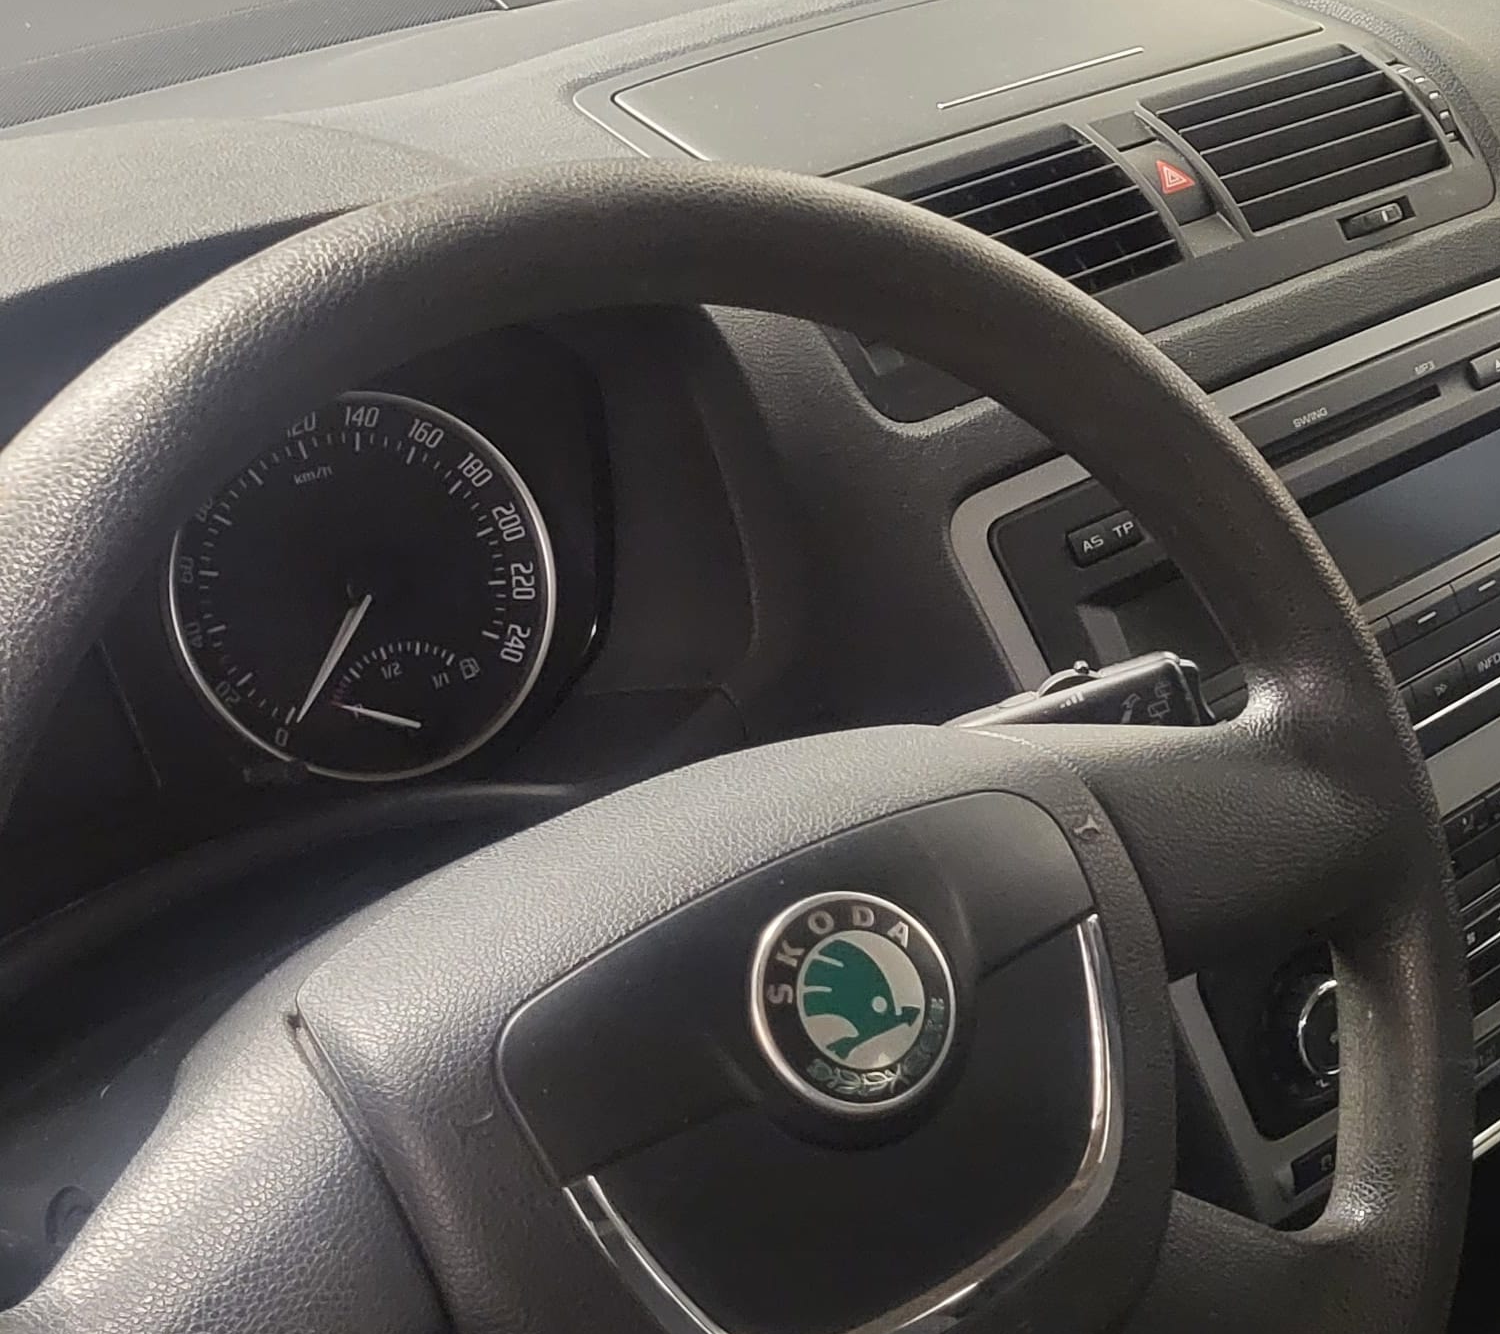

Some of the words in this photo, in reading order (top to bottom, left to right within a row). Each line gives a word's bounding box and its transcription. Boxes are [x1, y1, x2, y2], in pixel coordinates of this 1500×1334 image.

[345, 406, 380, 428] 140
[408, 418, 445, 449] 160
[1292, 407, 1328, 428] SWING
[457, 452, 494, 487] 180
[492, 501, 526, 542] 200
[1083, 534, 1104, 553] AS
[1112, 520, 1134, 538] TP
[510, 561, 536, 600] 220
[500, 624, 531, 663] 240
[275, 727, 288, 746] 0
